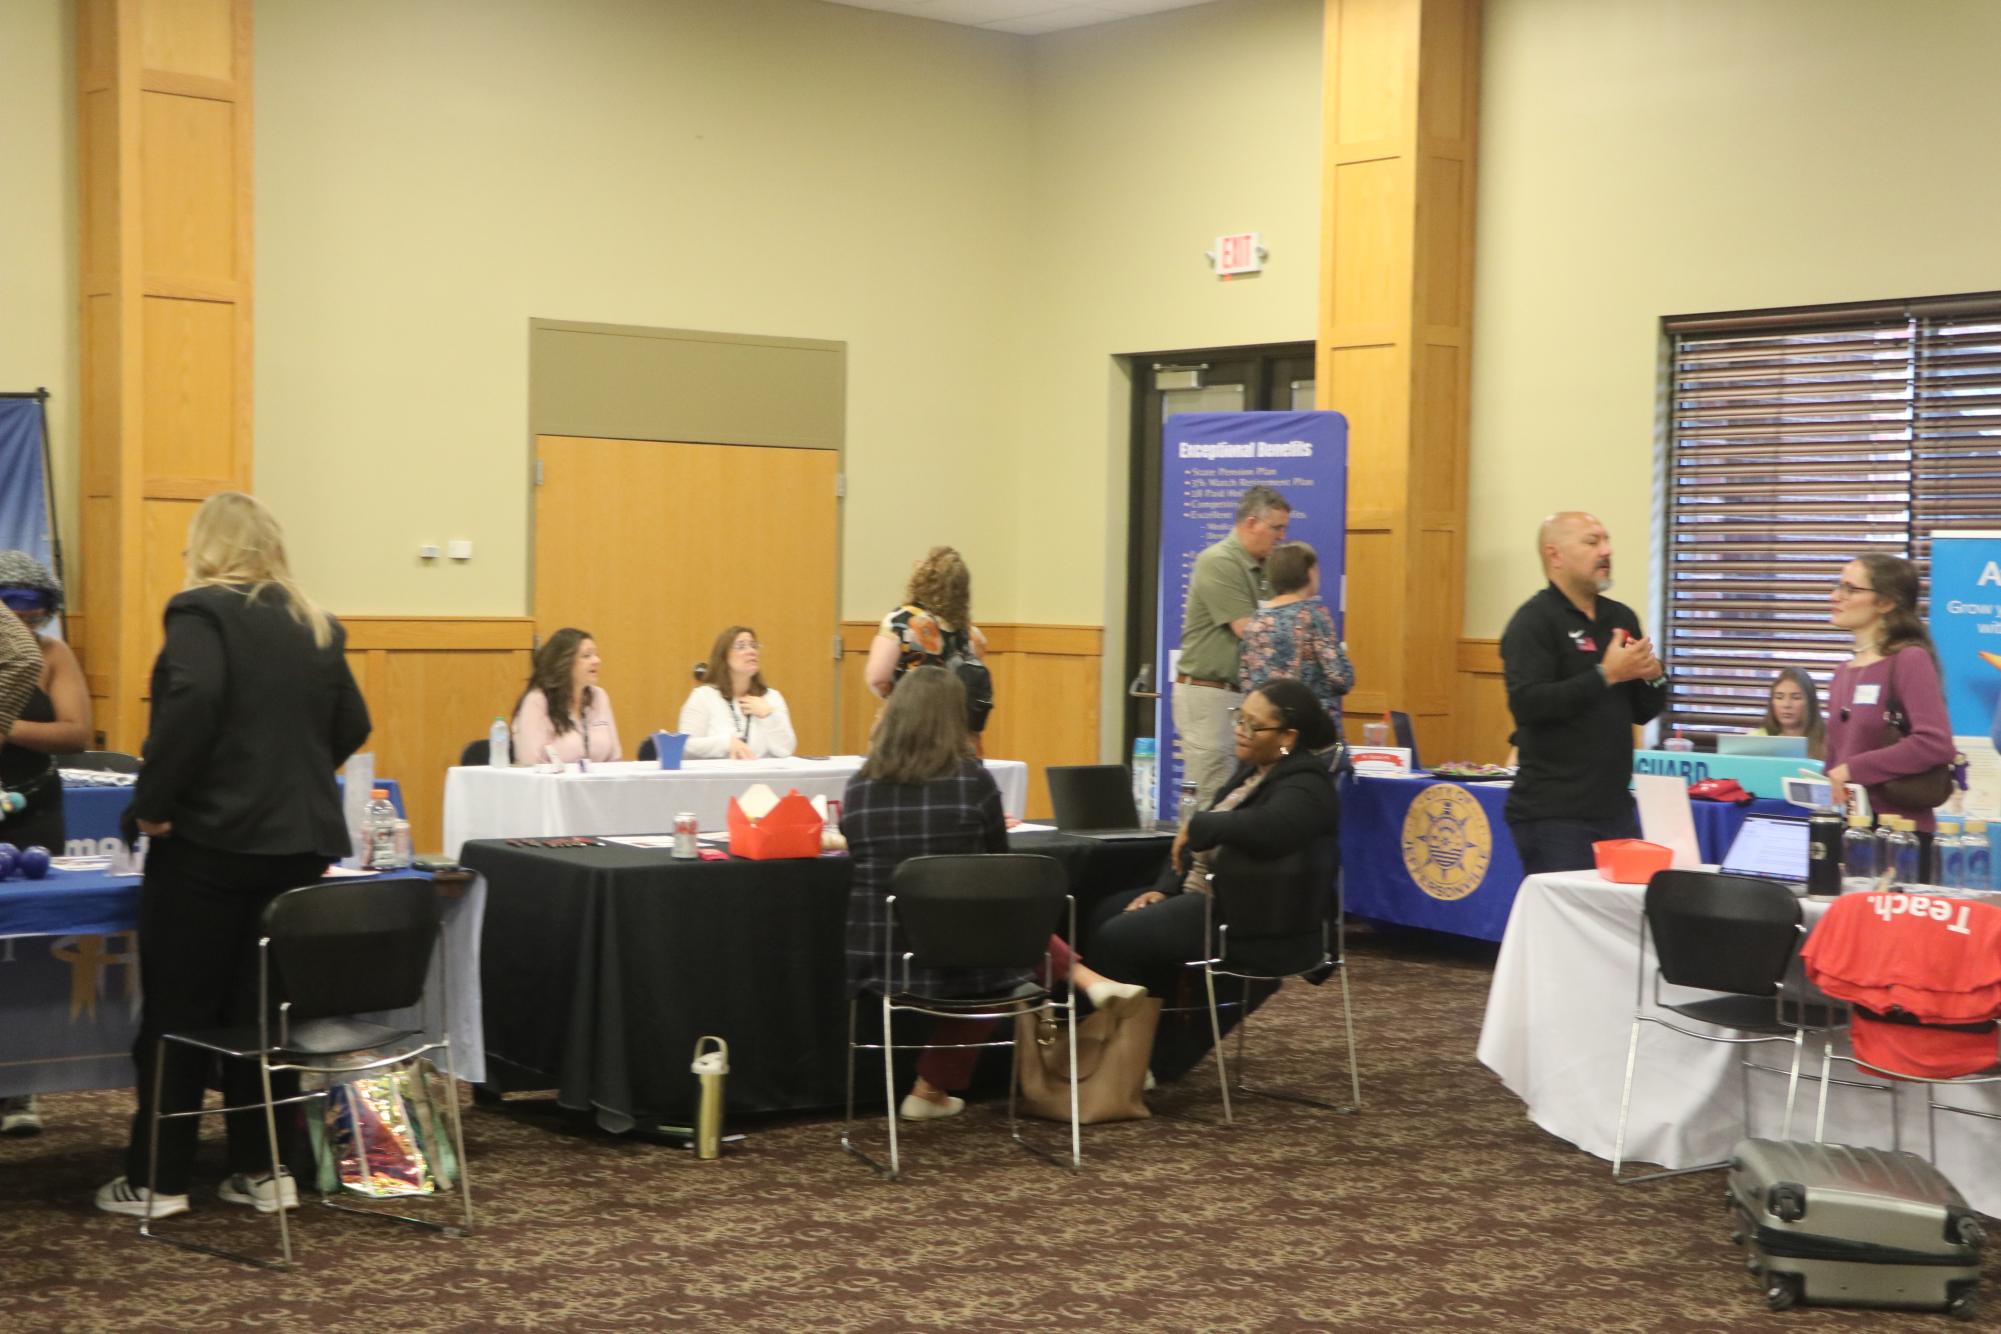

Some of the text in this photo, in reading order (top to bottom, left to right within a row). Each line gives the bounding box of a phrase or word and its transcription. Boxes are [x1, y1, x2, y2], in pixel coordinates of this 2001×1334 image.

[1222, 234, 1252, 269] EXIT
[1179, 440, 1313, 460] Exceptional Benefits
[1946, 600, 1992, 614] Grow
[1867, 895, 1971, 935] Teach.
